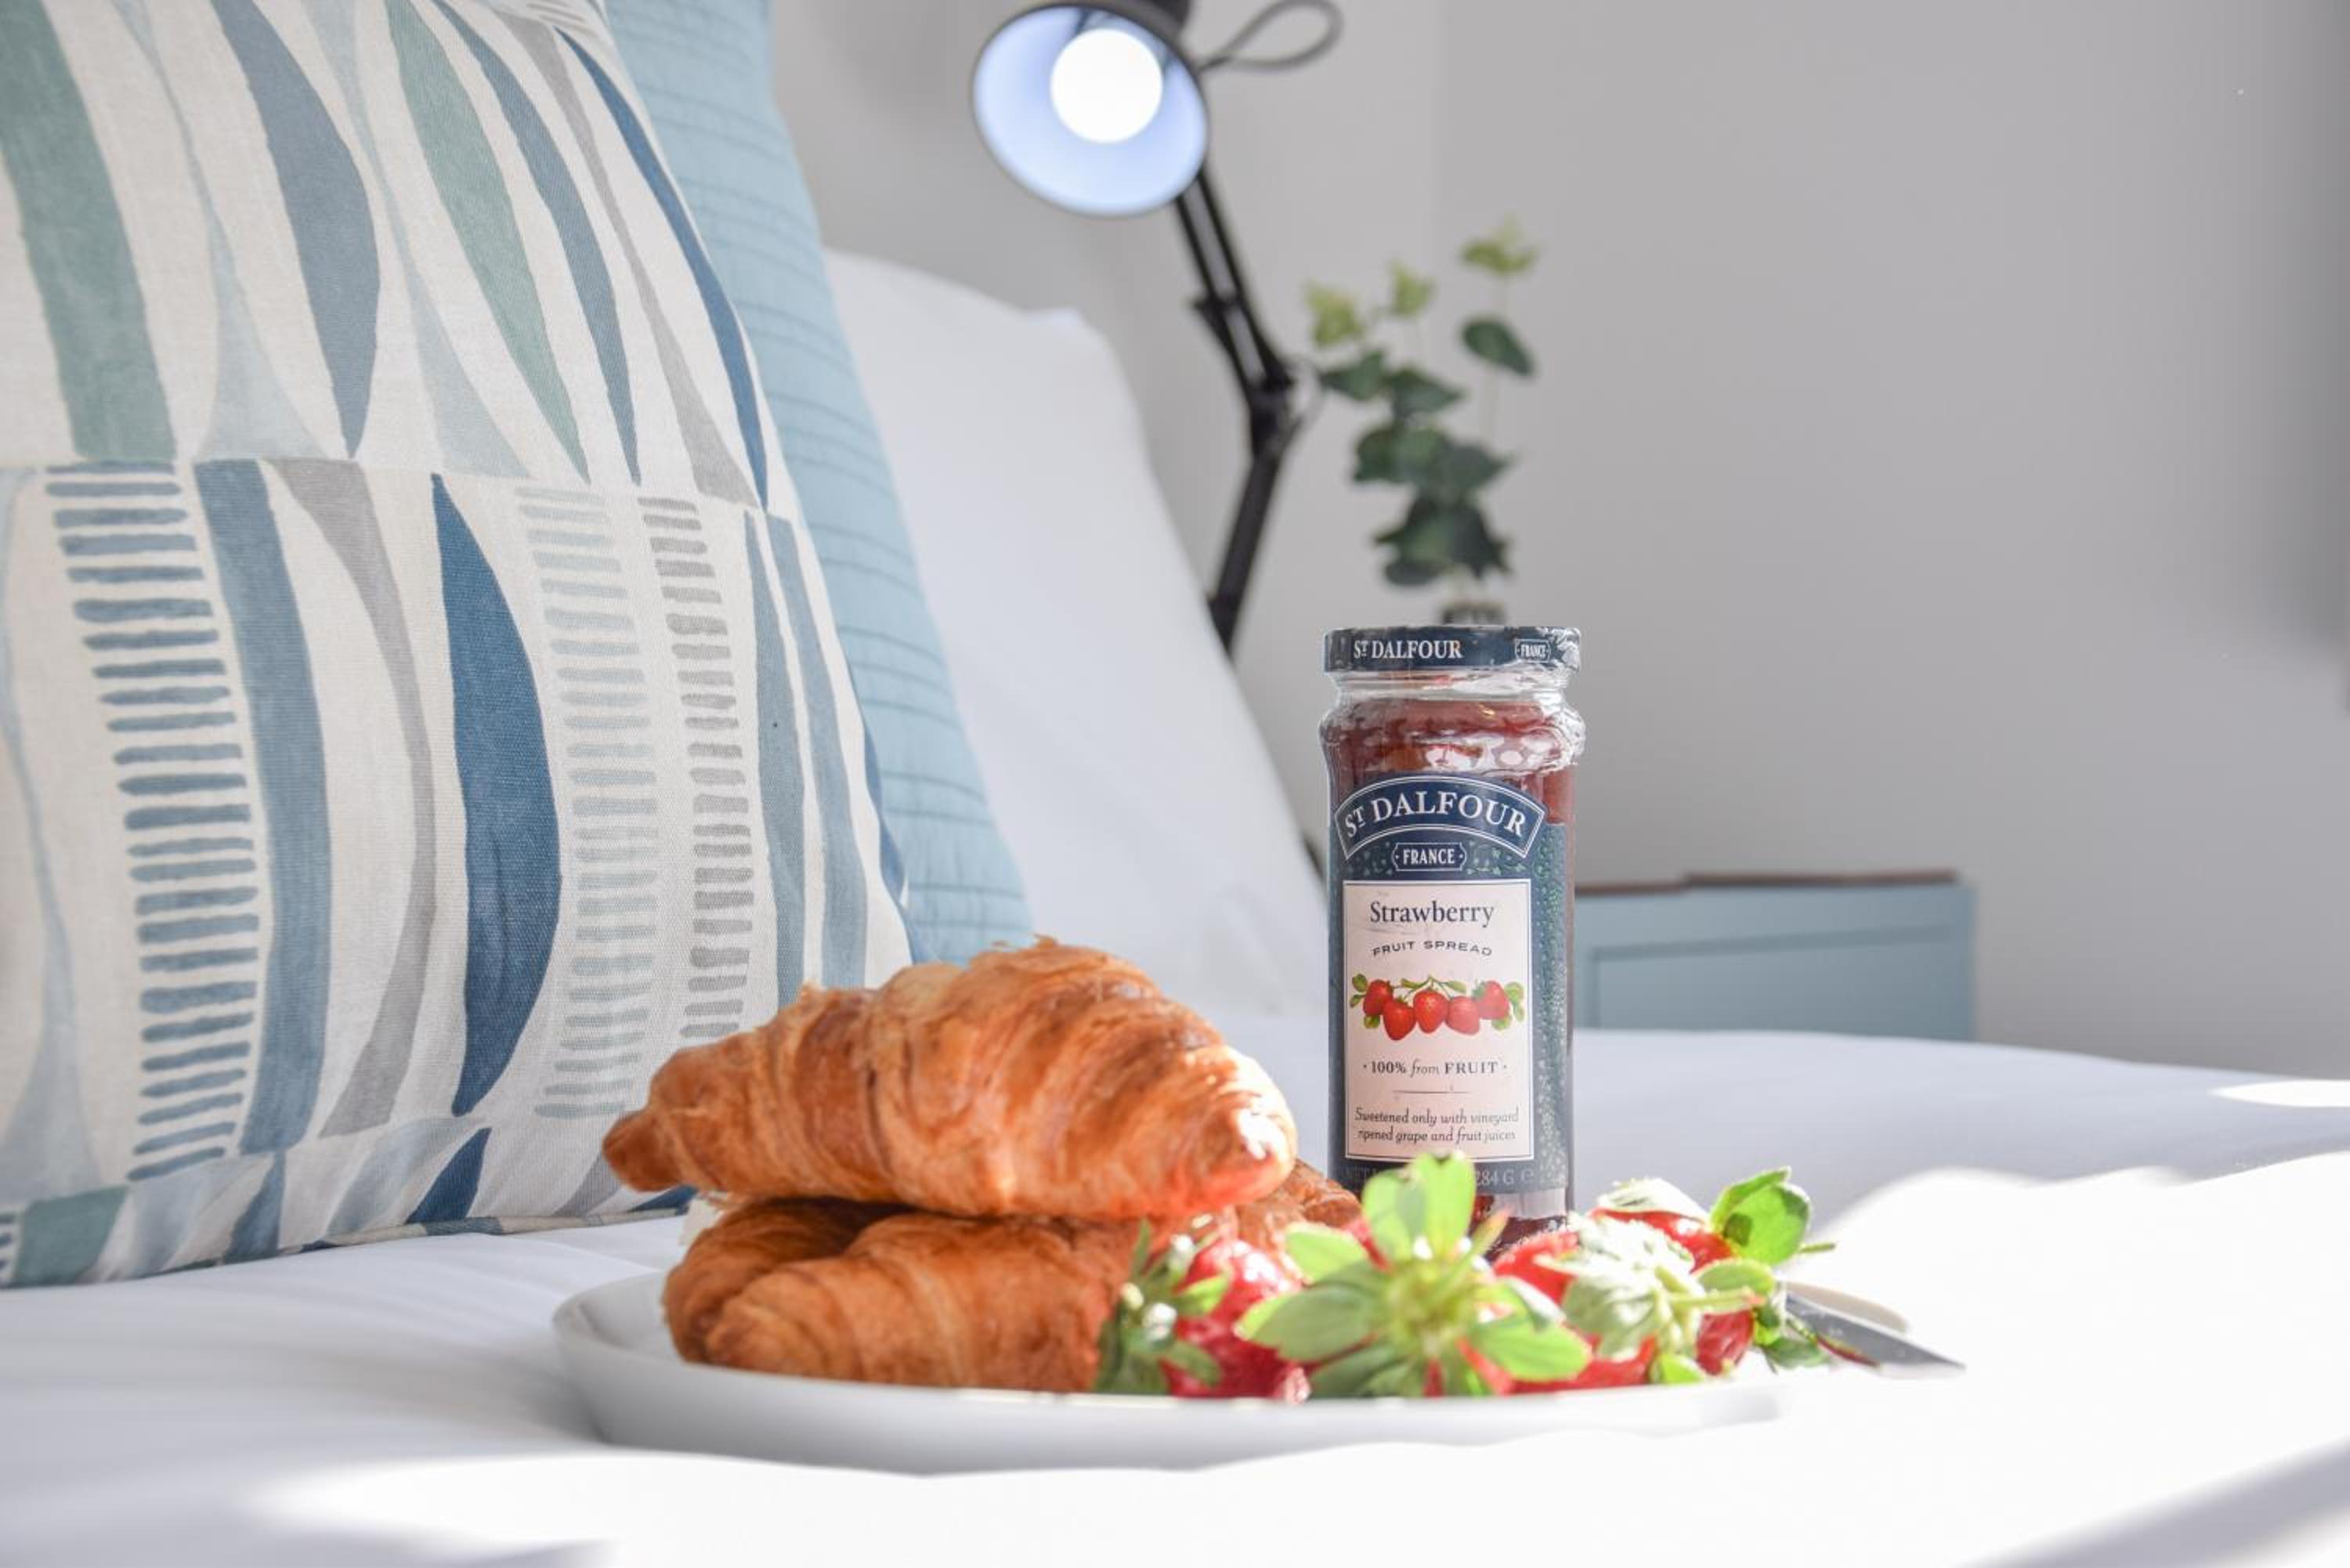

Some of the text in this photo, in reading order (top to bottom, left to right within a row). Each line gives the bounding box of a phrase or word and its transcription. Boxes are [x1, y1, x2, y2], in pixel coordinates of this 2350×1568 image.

[1371, 639, 1462, 659] DALFOUR
[1520, 643, 1546, 658] FRANCE
[1371, 791, 1527, 837] DALFOUR
[1403, 848, 1455, 865] FRANCE
[1370, 900, 1495, 928] Strawberry
[1372, 941, 1492, 956] FRUIT SPREAD
[1371, 1059, 1498, 1078] 100% from FRUIT
[1354, 1106, 1519, 1127] Sweetened only with vineyard
[1358, 1125, 1516, 1145] ripened grape and fruit juices
[1503, 1169, 1514, 1184] G
